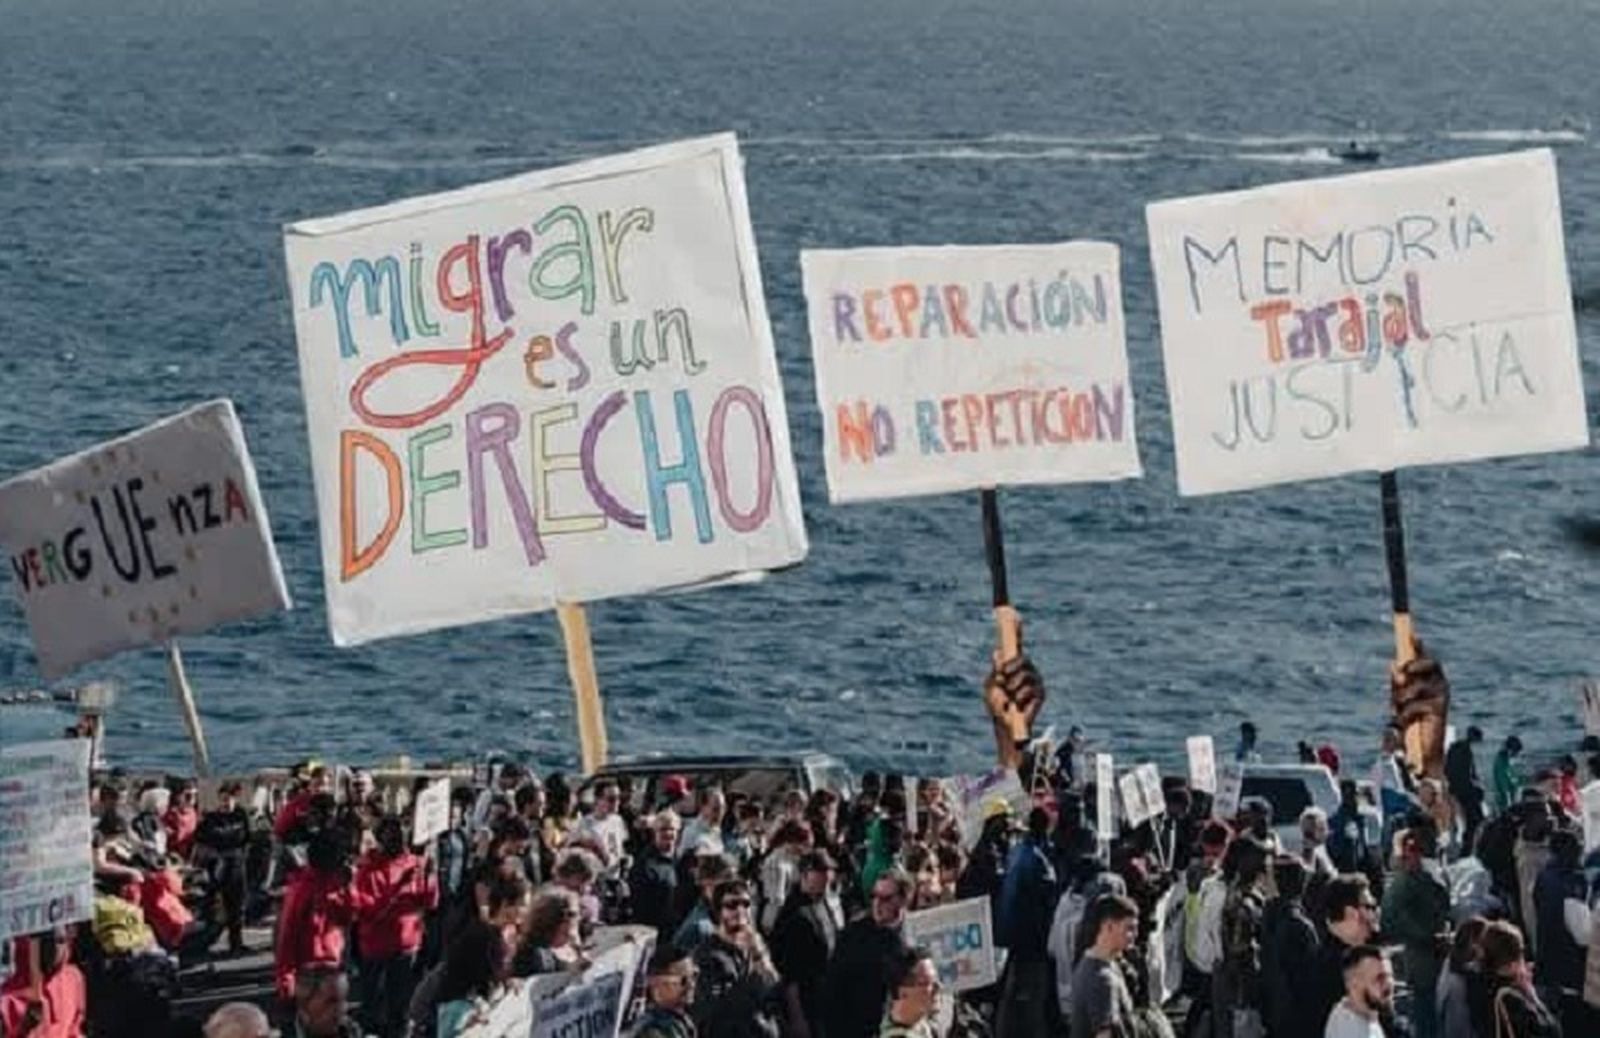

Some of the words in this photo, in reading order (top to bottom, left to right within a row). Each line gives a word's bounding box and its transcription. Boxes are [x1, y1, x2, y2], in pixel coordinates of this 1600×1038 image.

[310, 204, 654, 429] migrar
[523, 321, 591, 392] es
[611, 307, 706, 375] un
[1250, 270, 1431, 374] Tarajal
[836, 399, 896, 464] NO
[340, 386, 775, 584] DERECHO
